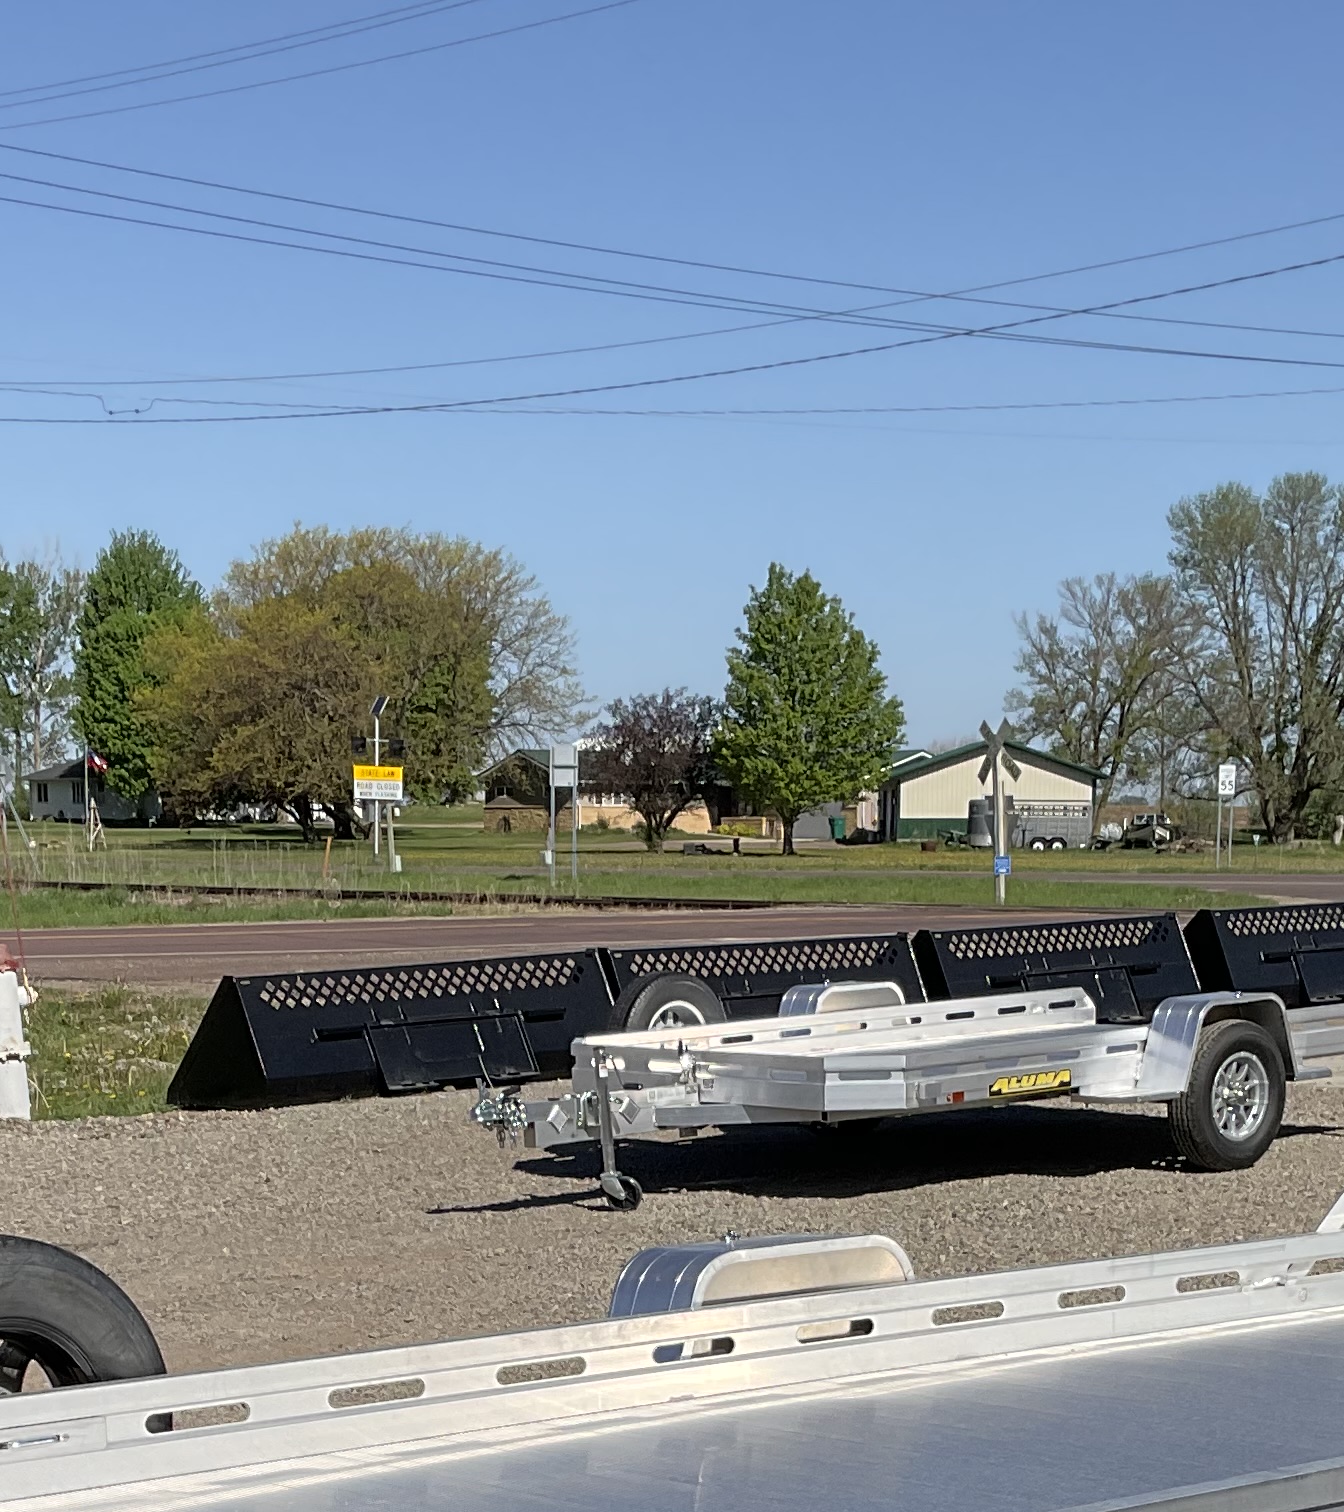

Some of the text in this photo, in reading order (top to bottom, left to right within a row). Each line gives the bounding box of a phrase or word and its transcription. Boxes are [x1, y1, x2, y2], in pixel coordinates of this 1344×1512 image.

[356, 781, 400, 791] ROAD CLOSED
[1220, 780, 1234, 791] 55
[990, 1069, 1071, 1095] ALUMA
